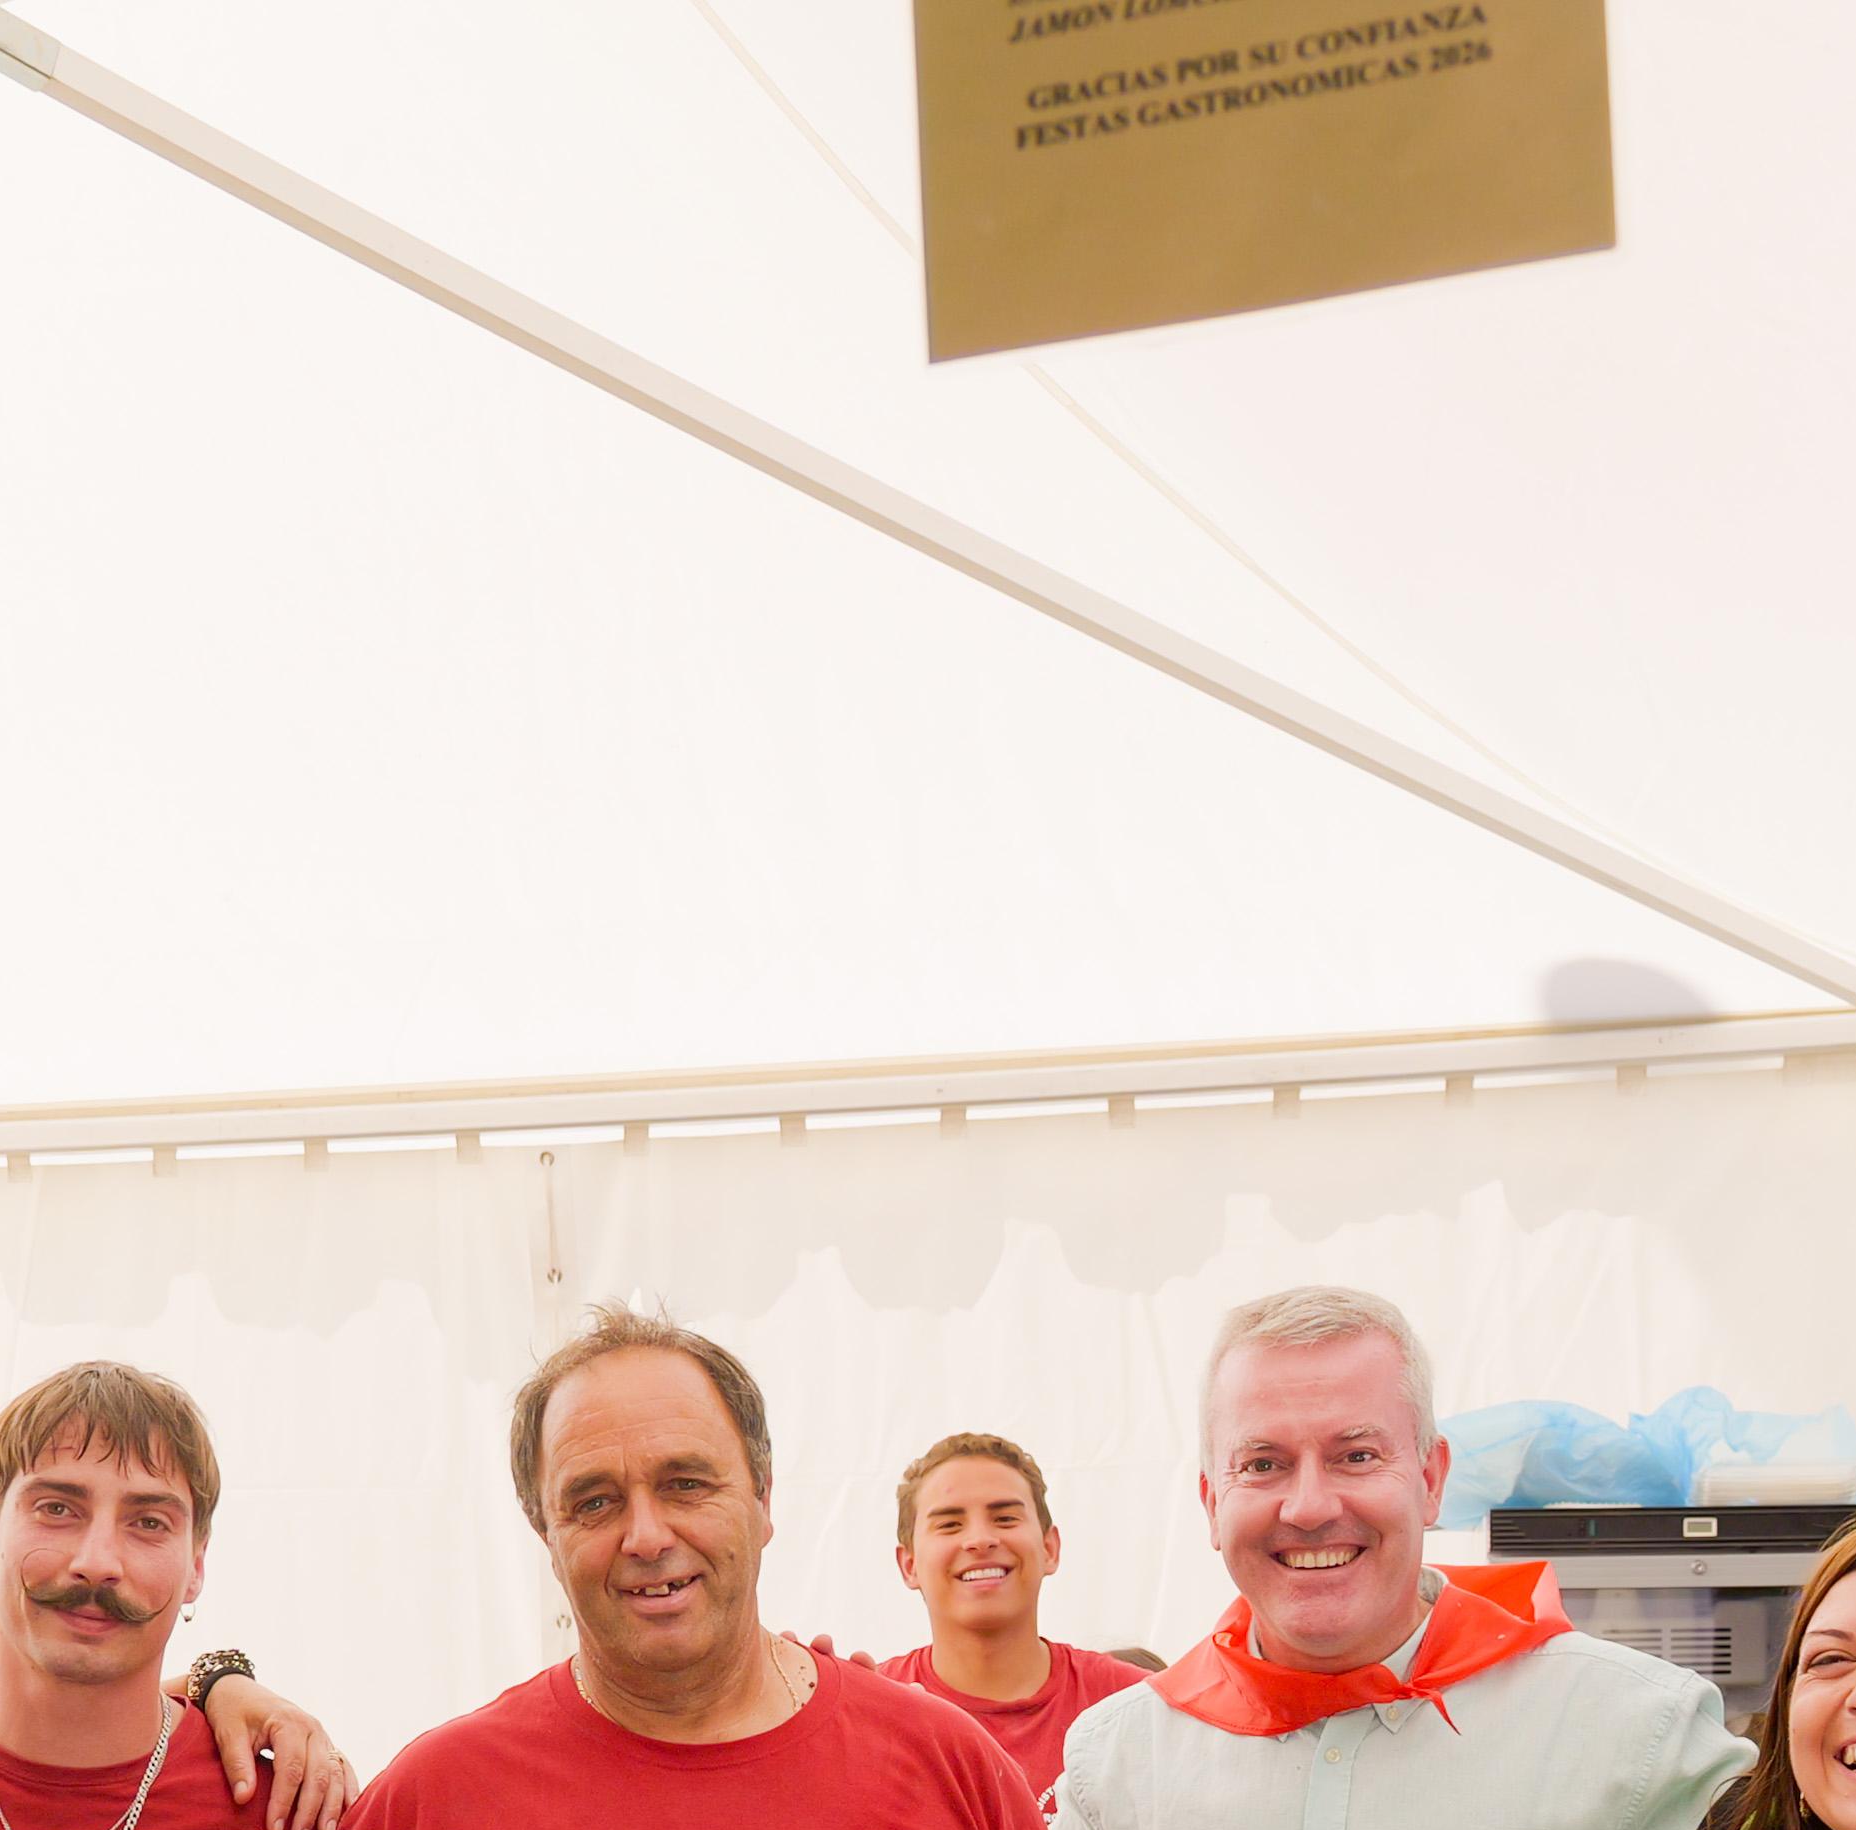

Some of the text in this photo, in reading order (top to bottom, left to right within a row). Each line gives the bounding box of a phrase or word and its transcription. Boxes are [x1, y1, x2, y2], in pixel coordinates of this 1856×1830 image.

[1008, 5, 1114, 44] JAMON
[1027, 4, 1487, 111] GRACIAS POR SU CONFIANZA
[1016, 107, 1130, 149] FESTAS
[1137, 53, 1420, 126] GASTRONOMICAS
